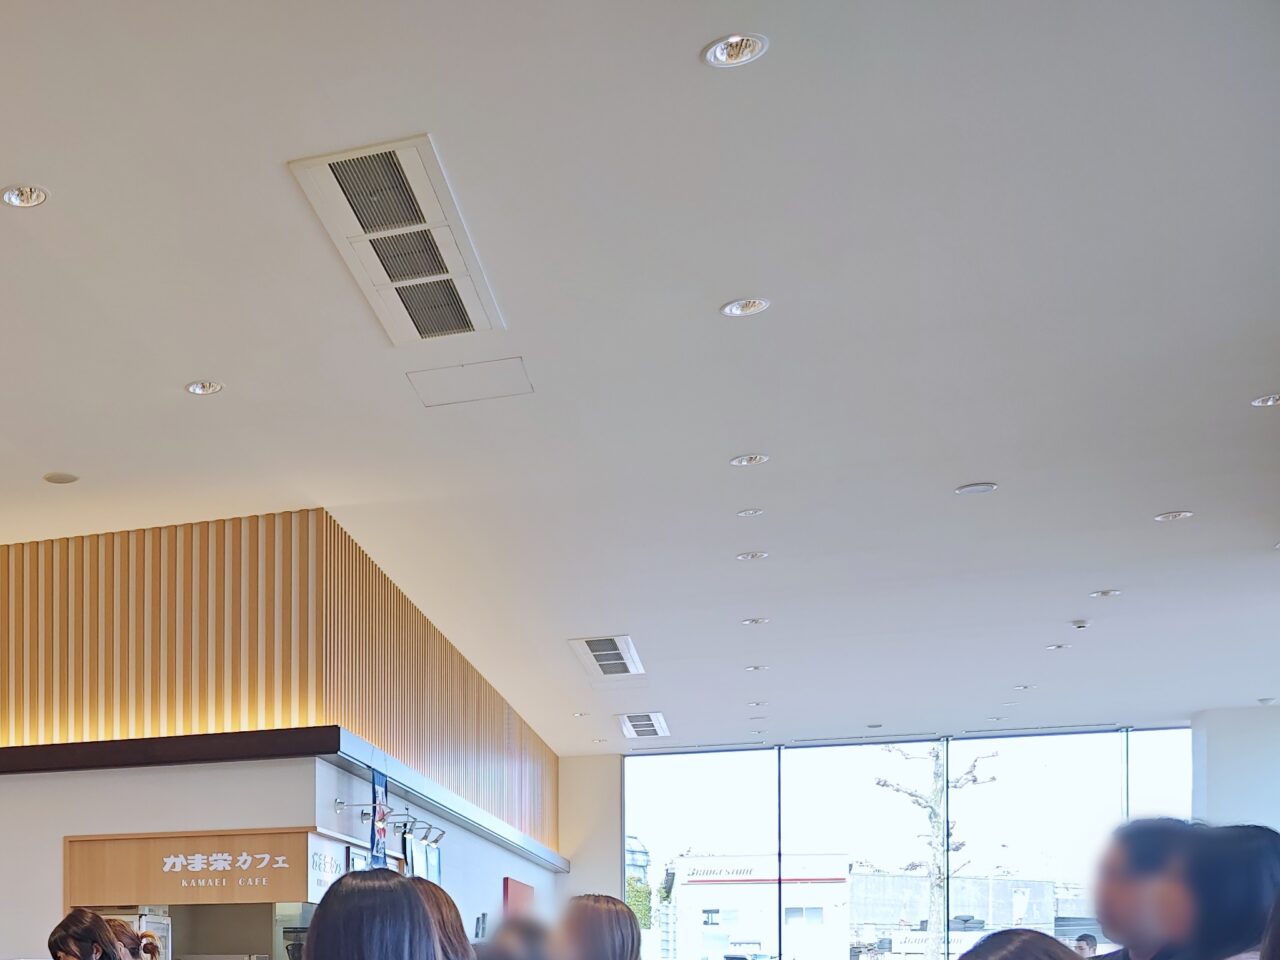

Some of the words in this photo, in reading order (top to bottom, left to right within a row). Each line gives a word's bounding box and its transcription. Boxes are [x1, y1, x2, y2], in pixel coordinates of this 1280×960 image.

[163, 852, 289, 873] かま栄カフェ
[181, 878, 227, 888] KAMAEI
[238, 877, 269, 886] CAFE
